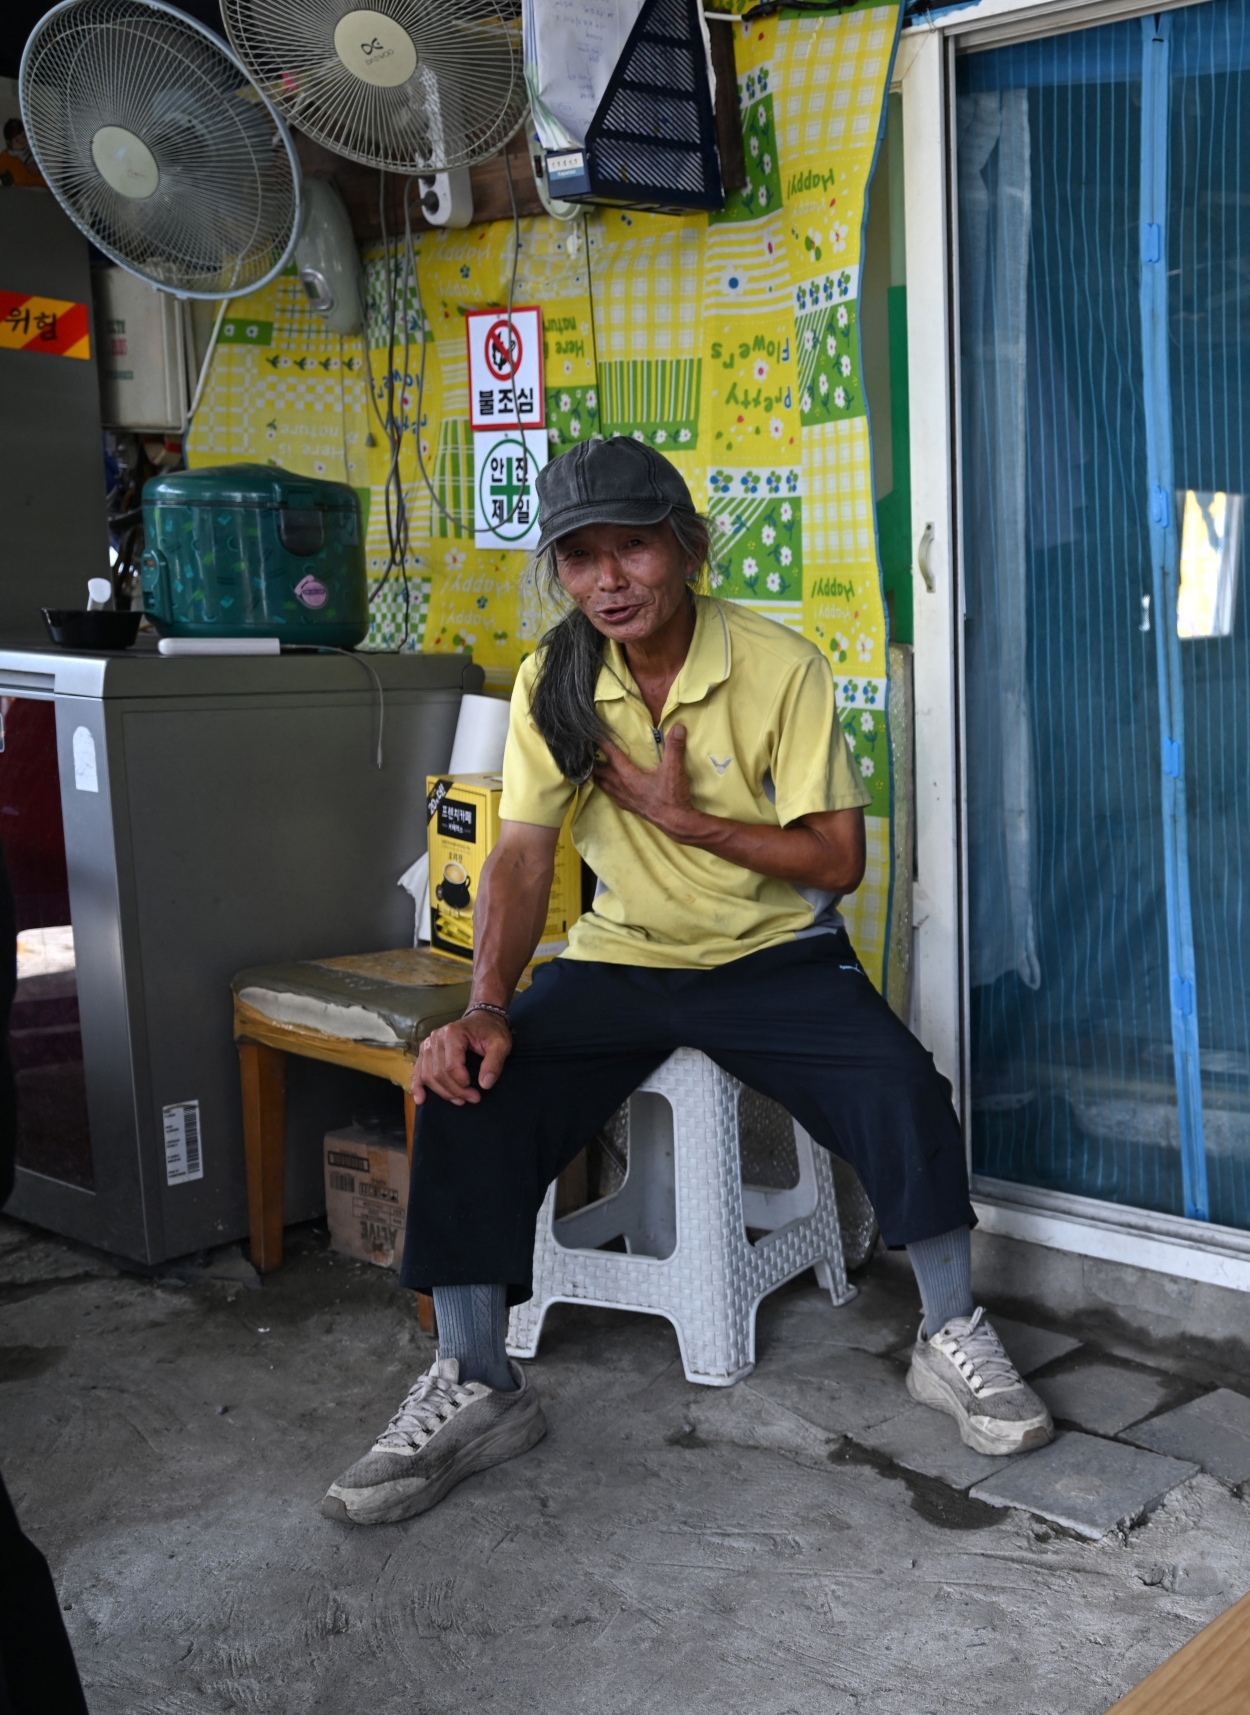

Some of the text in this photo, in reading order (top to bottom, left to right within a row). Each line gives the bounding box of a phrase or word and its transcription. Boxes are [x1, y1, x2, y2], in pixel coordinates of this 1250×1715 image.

[787, 168, 834, 201] Happy!
[5, 308, 58, 341] 위험
[543, 316, 578, 335] natur
[711, 335, 790, 369] Flowers
[479, 388, 534, 416] 불조심
[725, 383, 792, 413] Pretty
[811, 577, 855, 602] Happy!
